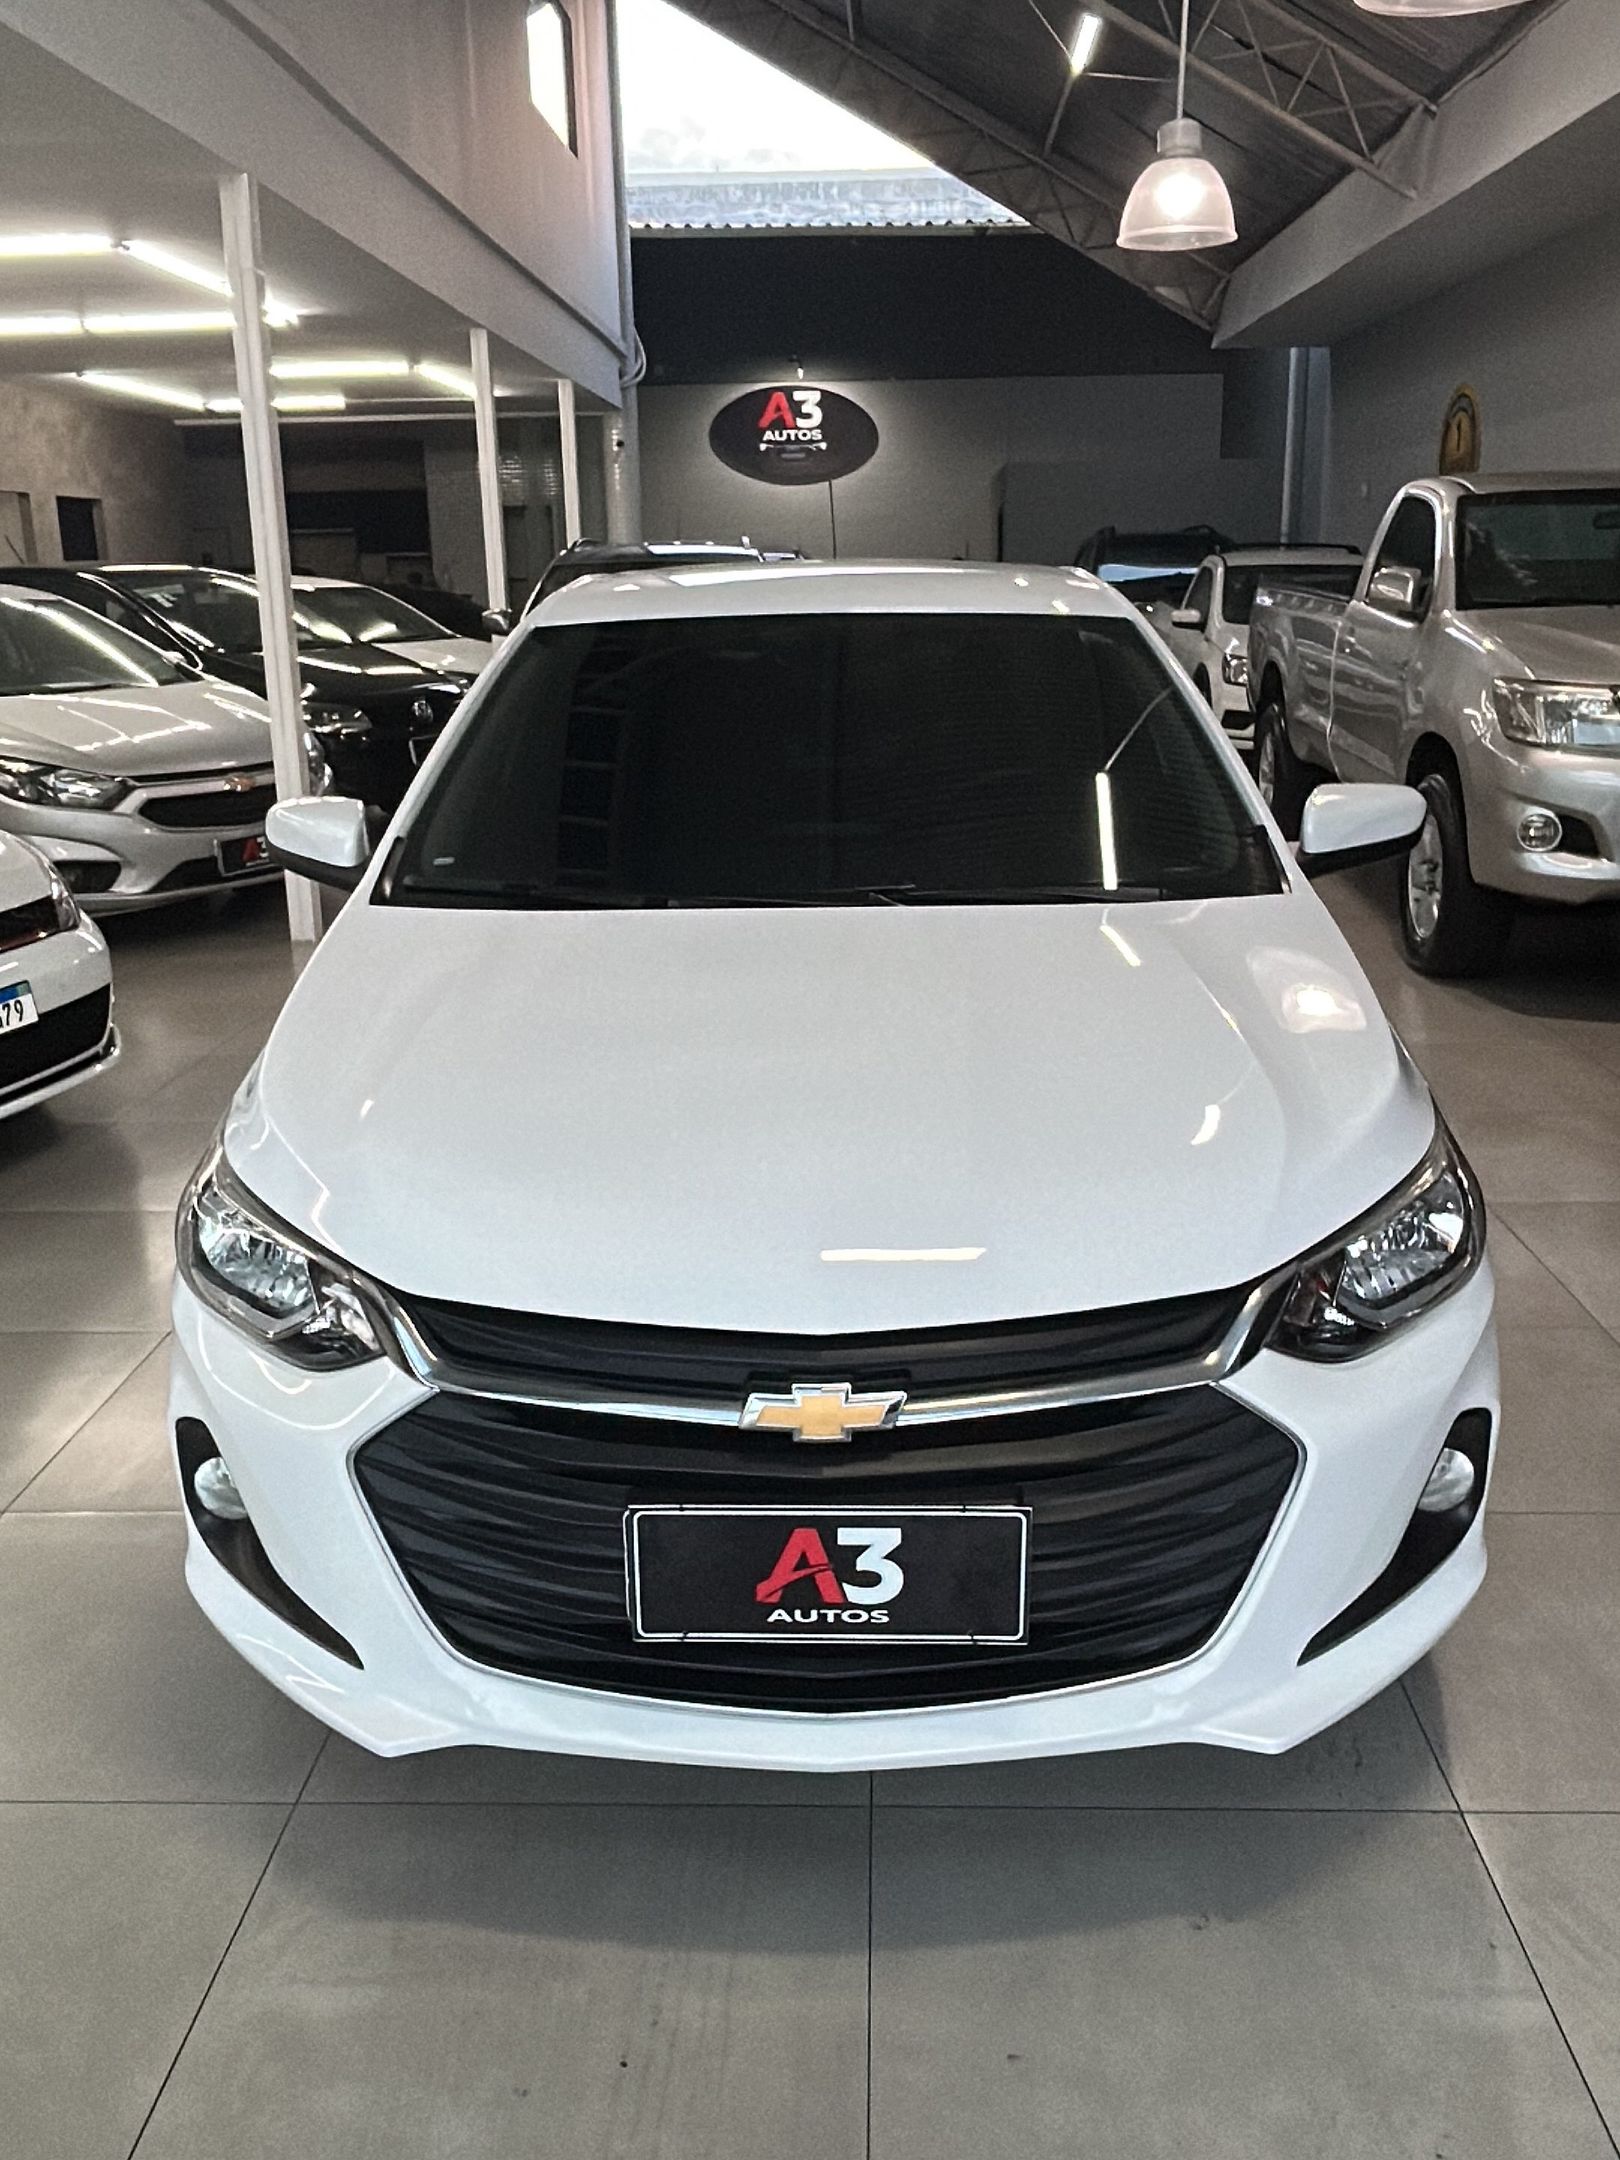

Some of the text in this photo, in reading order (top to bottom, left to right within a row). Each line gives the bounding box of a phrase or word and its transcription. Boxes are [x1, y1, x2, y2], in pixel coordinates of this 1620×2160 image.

[757, 390, 823, 429] A3
[762, 429, 823, 442] AUTOS
[754, 1527, 904, 1605] A3
[766, 1608, 890, 1624] AUTOS
